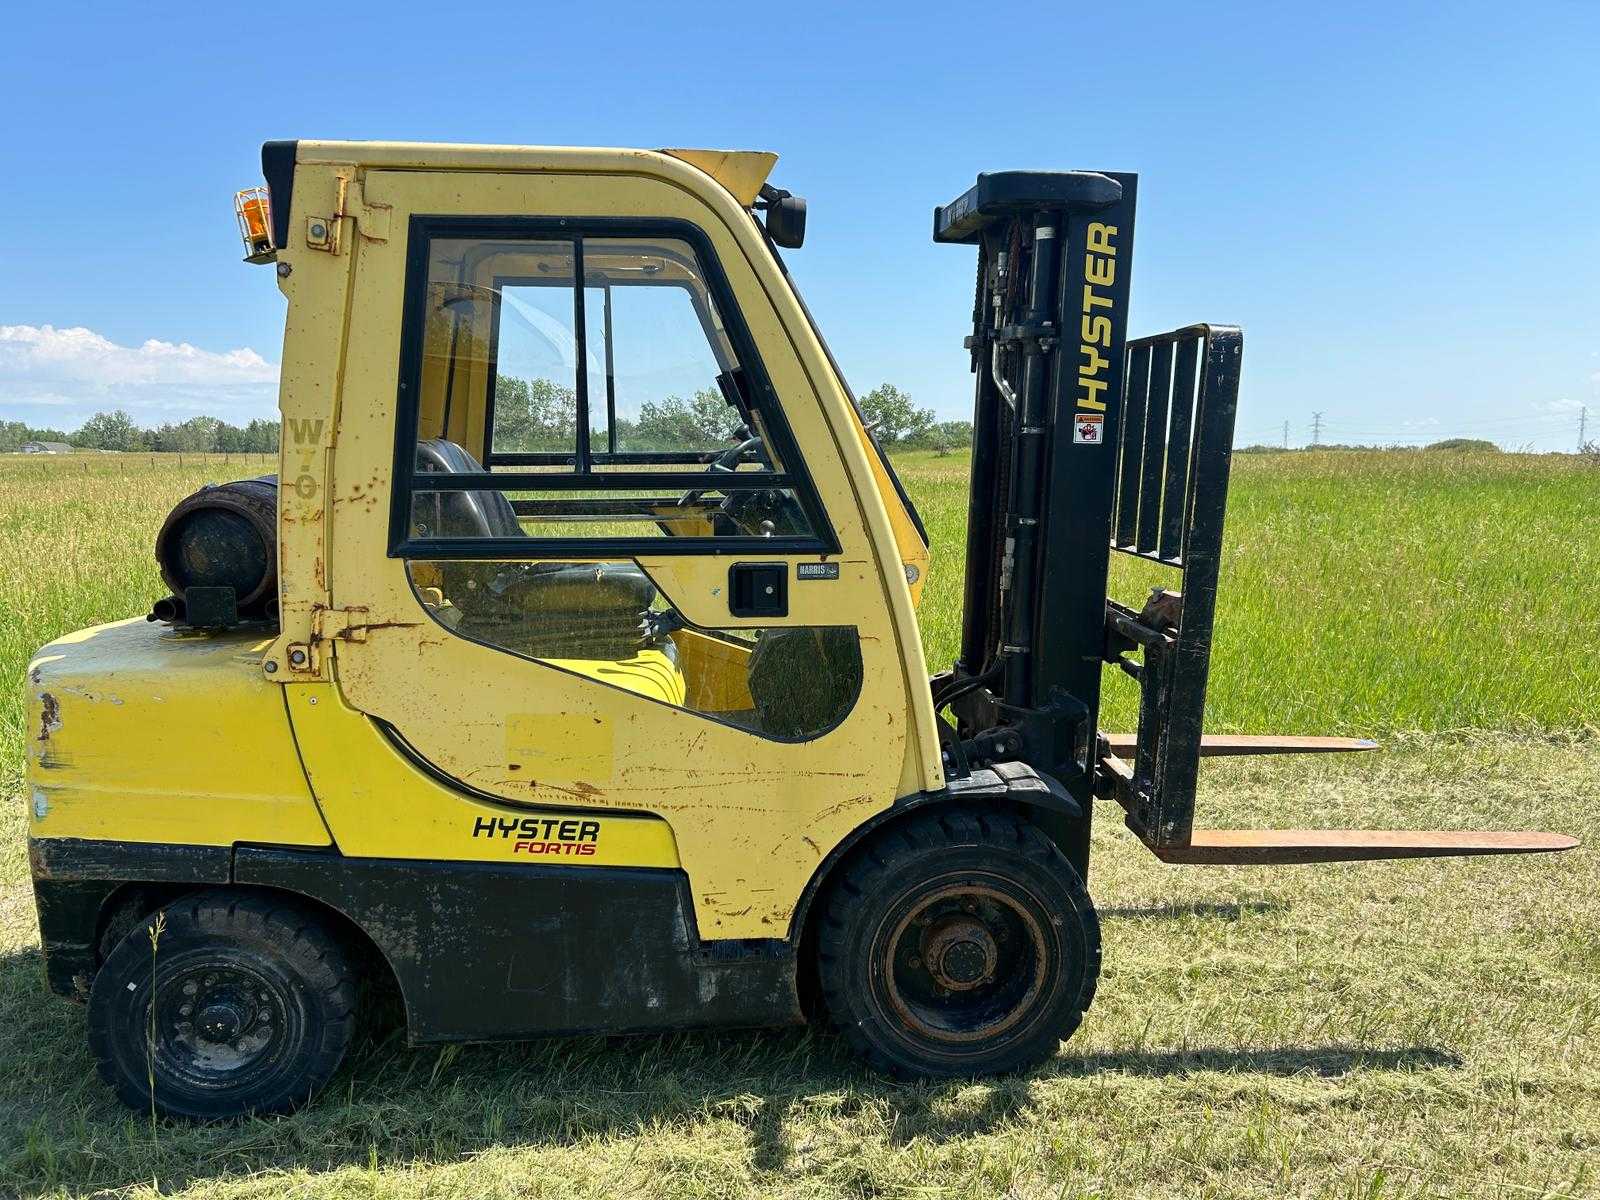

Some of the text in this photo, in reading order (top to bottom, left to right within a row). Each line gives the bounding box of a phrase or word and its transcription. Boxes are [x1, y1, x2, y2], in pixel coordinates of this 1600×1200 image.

[1077, 222, 1118, 411] HYSTER
[800, 565, 826, 575] HARRIS
[472, 816, 600, 842] HYSTER
[513, 841, 597, 856] FORTIS
